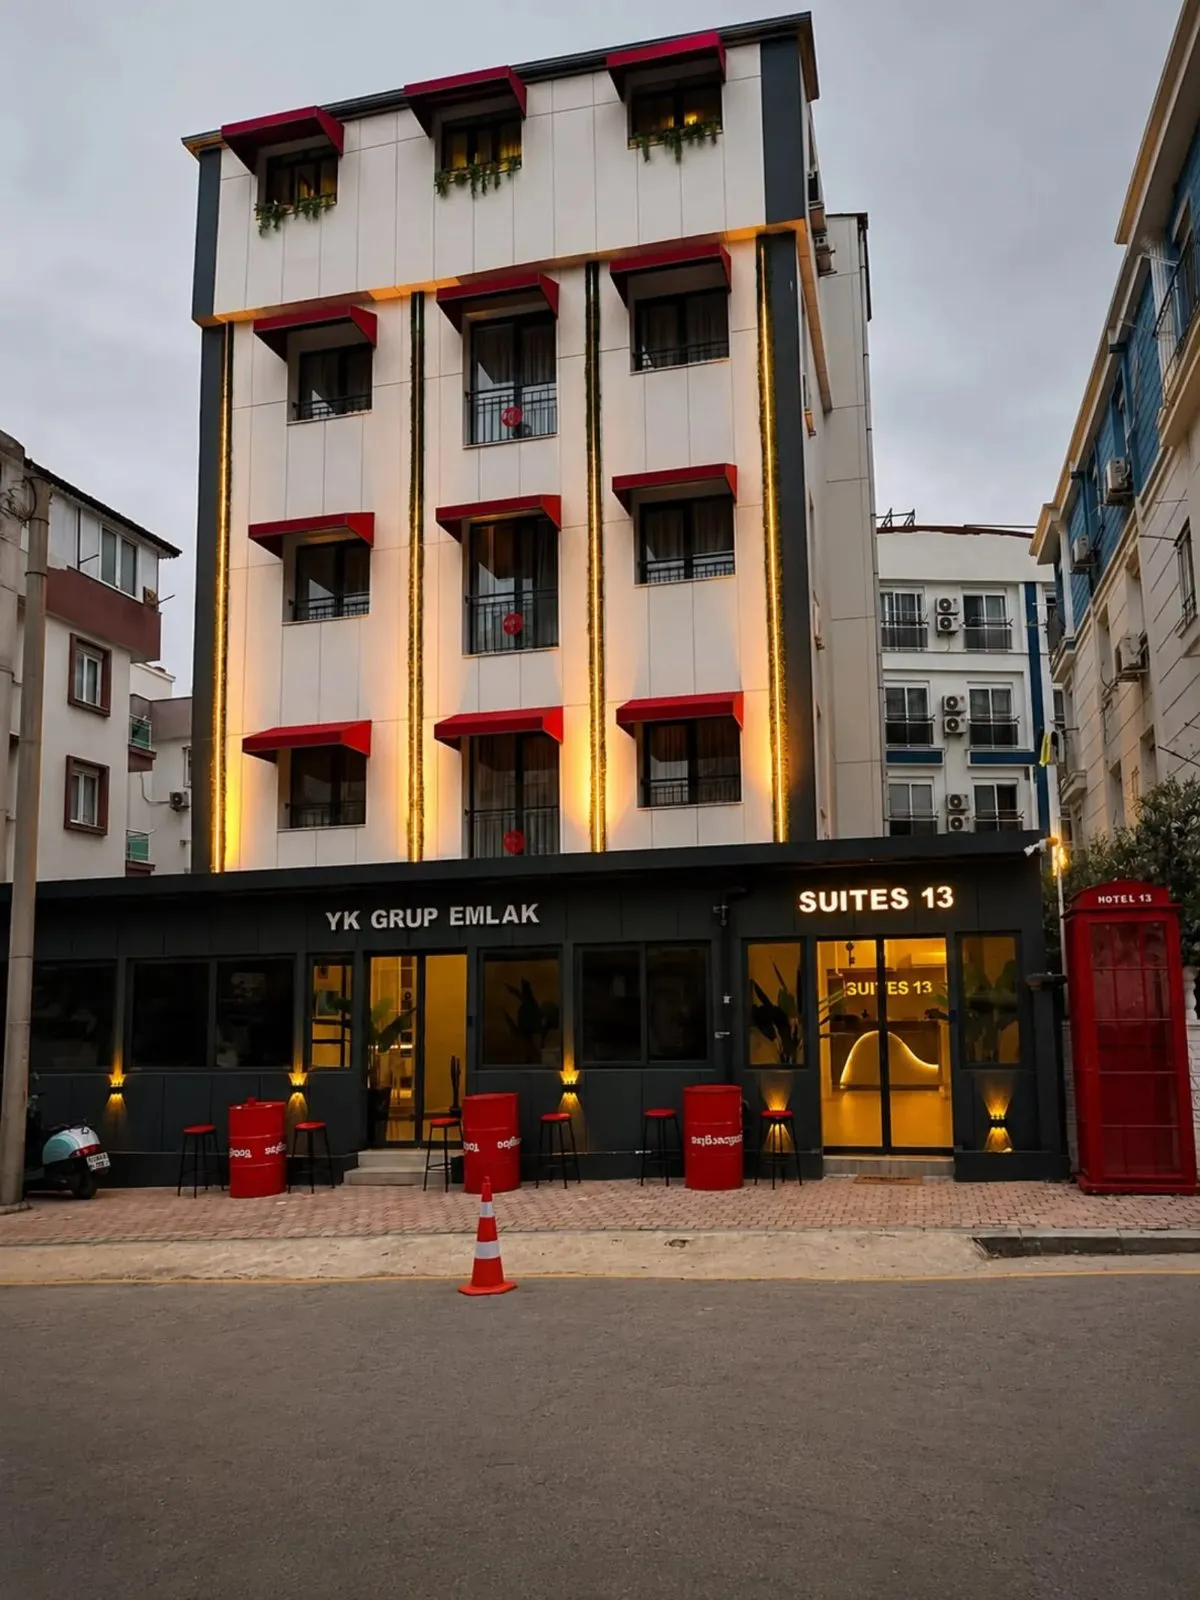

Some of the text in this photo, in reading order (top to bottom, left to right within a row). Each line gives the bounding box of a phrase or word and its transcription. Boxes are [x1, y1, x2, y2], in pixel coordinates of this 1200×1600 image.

[799, 885, 954, 913] SUITES 13
[1097, 893, 1152, 904] HOTEL 13
[325, 903, 540, 931] YK GRUP EMLAK
[846, 980, 933, 996] SUIES 13
